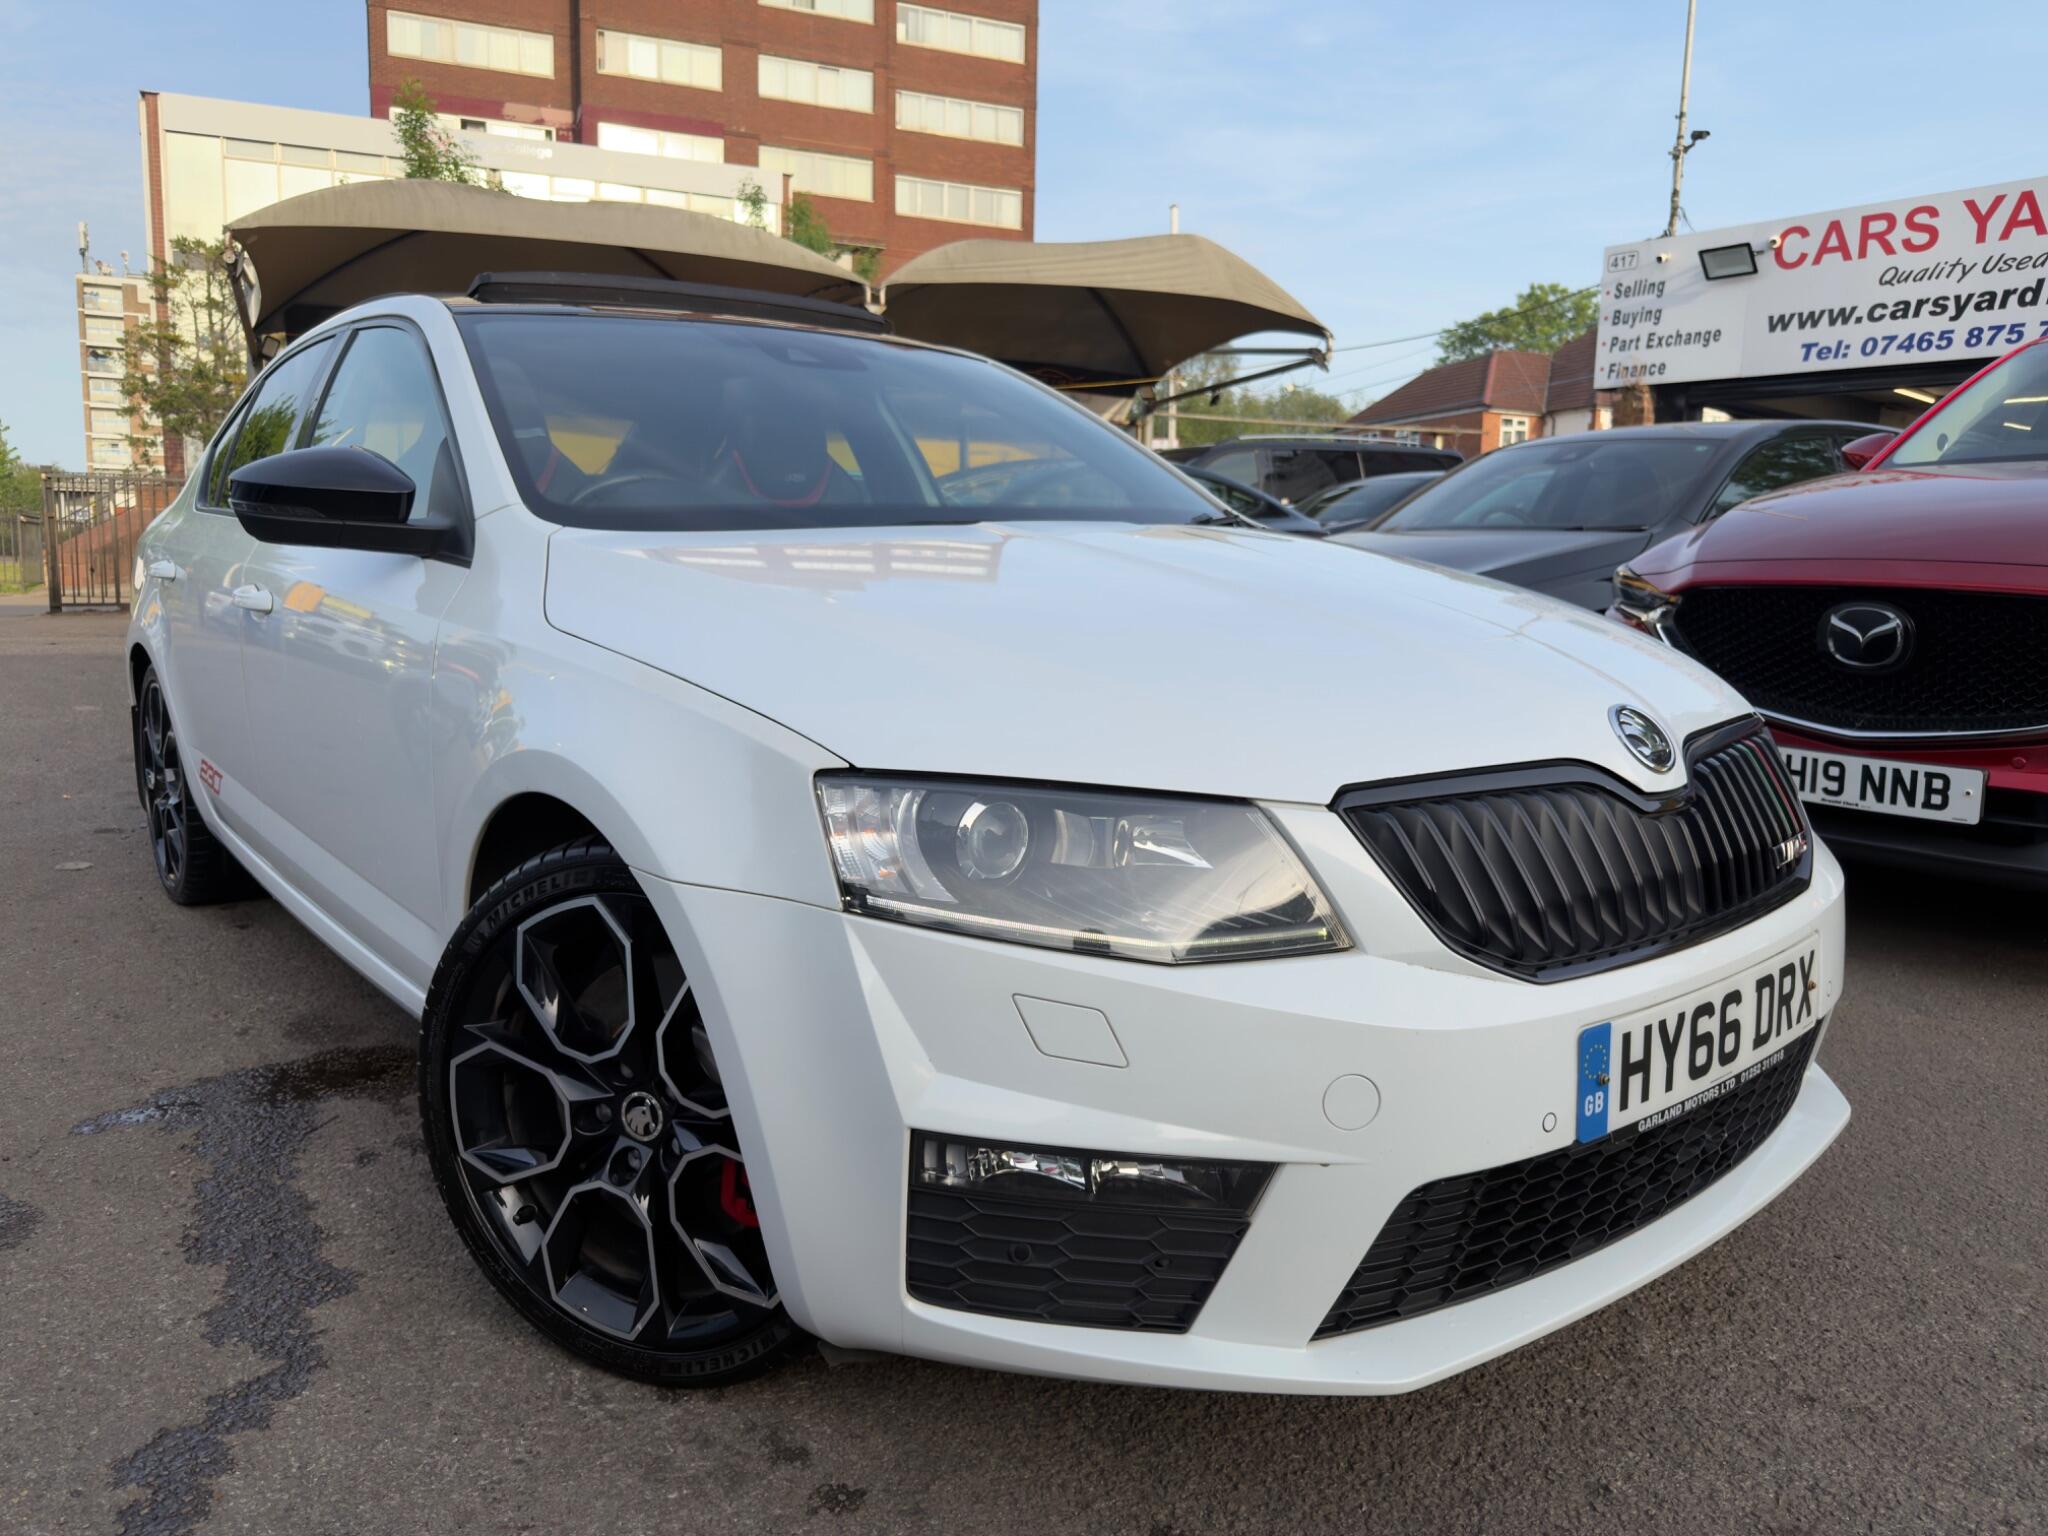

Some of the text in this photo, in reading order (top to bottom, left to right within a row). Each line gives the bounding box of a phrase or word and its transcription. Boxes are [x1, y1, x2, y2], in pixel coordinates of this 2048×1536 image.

[1774, 190, 2048, 270] CARS YA
[1610, 255, 1635, 268] 417
[1879, 257, 1978, 287] Quality
[1614, 279, 1665, 299] Selling
[1611, 306, 1662, 328] Buying
[1768, 277, 2048, 334] www.carsyard
[1609, 329, 1722, 353] Part Exchange
[1801, 340, 1851, 362] Tel:
[1860, 329, 1955, 357] 07465
[1964, 322, 2027, 348] 875
[1607, 362, 1666, 380] Finance
[1859, 764, 1951, 811] NNB
[1620, 950, 1815, 1112] HY66 DRX
[1584, 1091, 1604, 1117] GB
[1638, 1106, 1682, 1132] GARLAND
[1684, 1086, 1719, 1112] MOTORS
[1721, 1078, 1736, 1093] LTD
